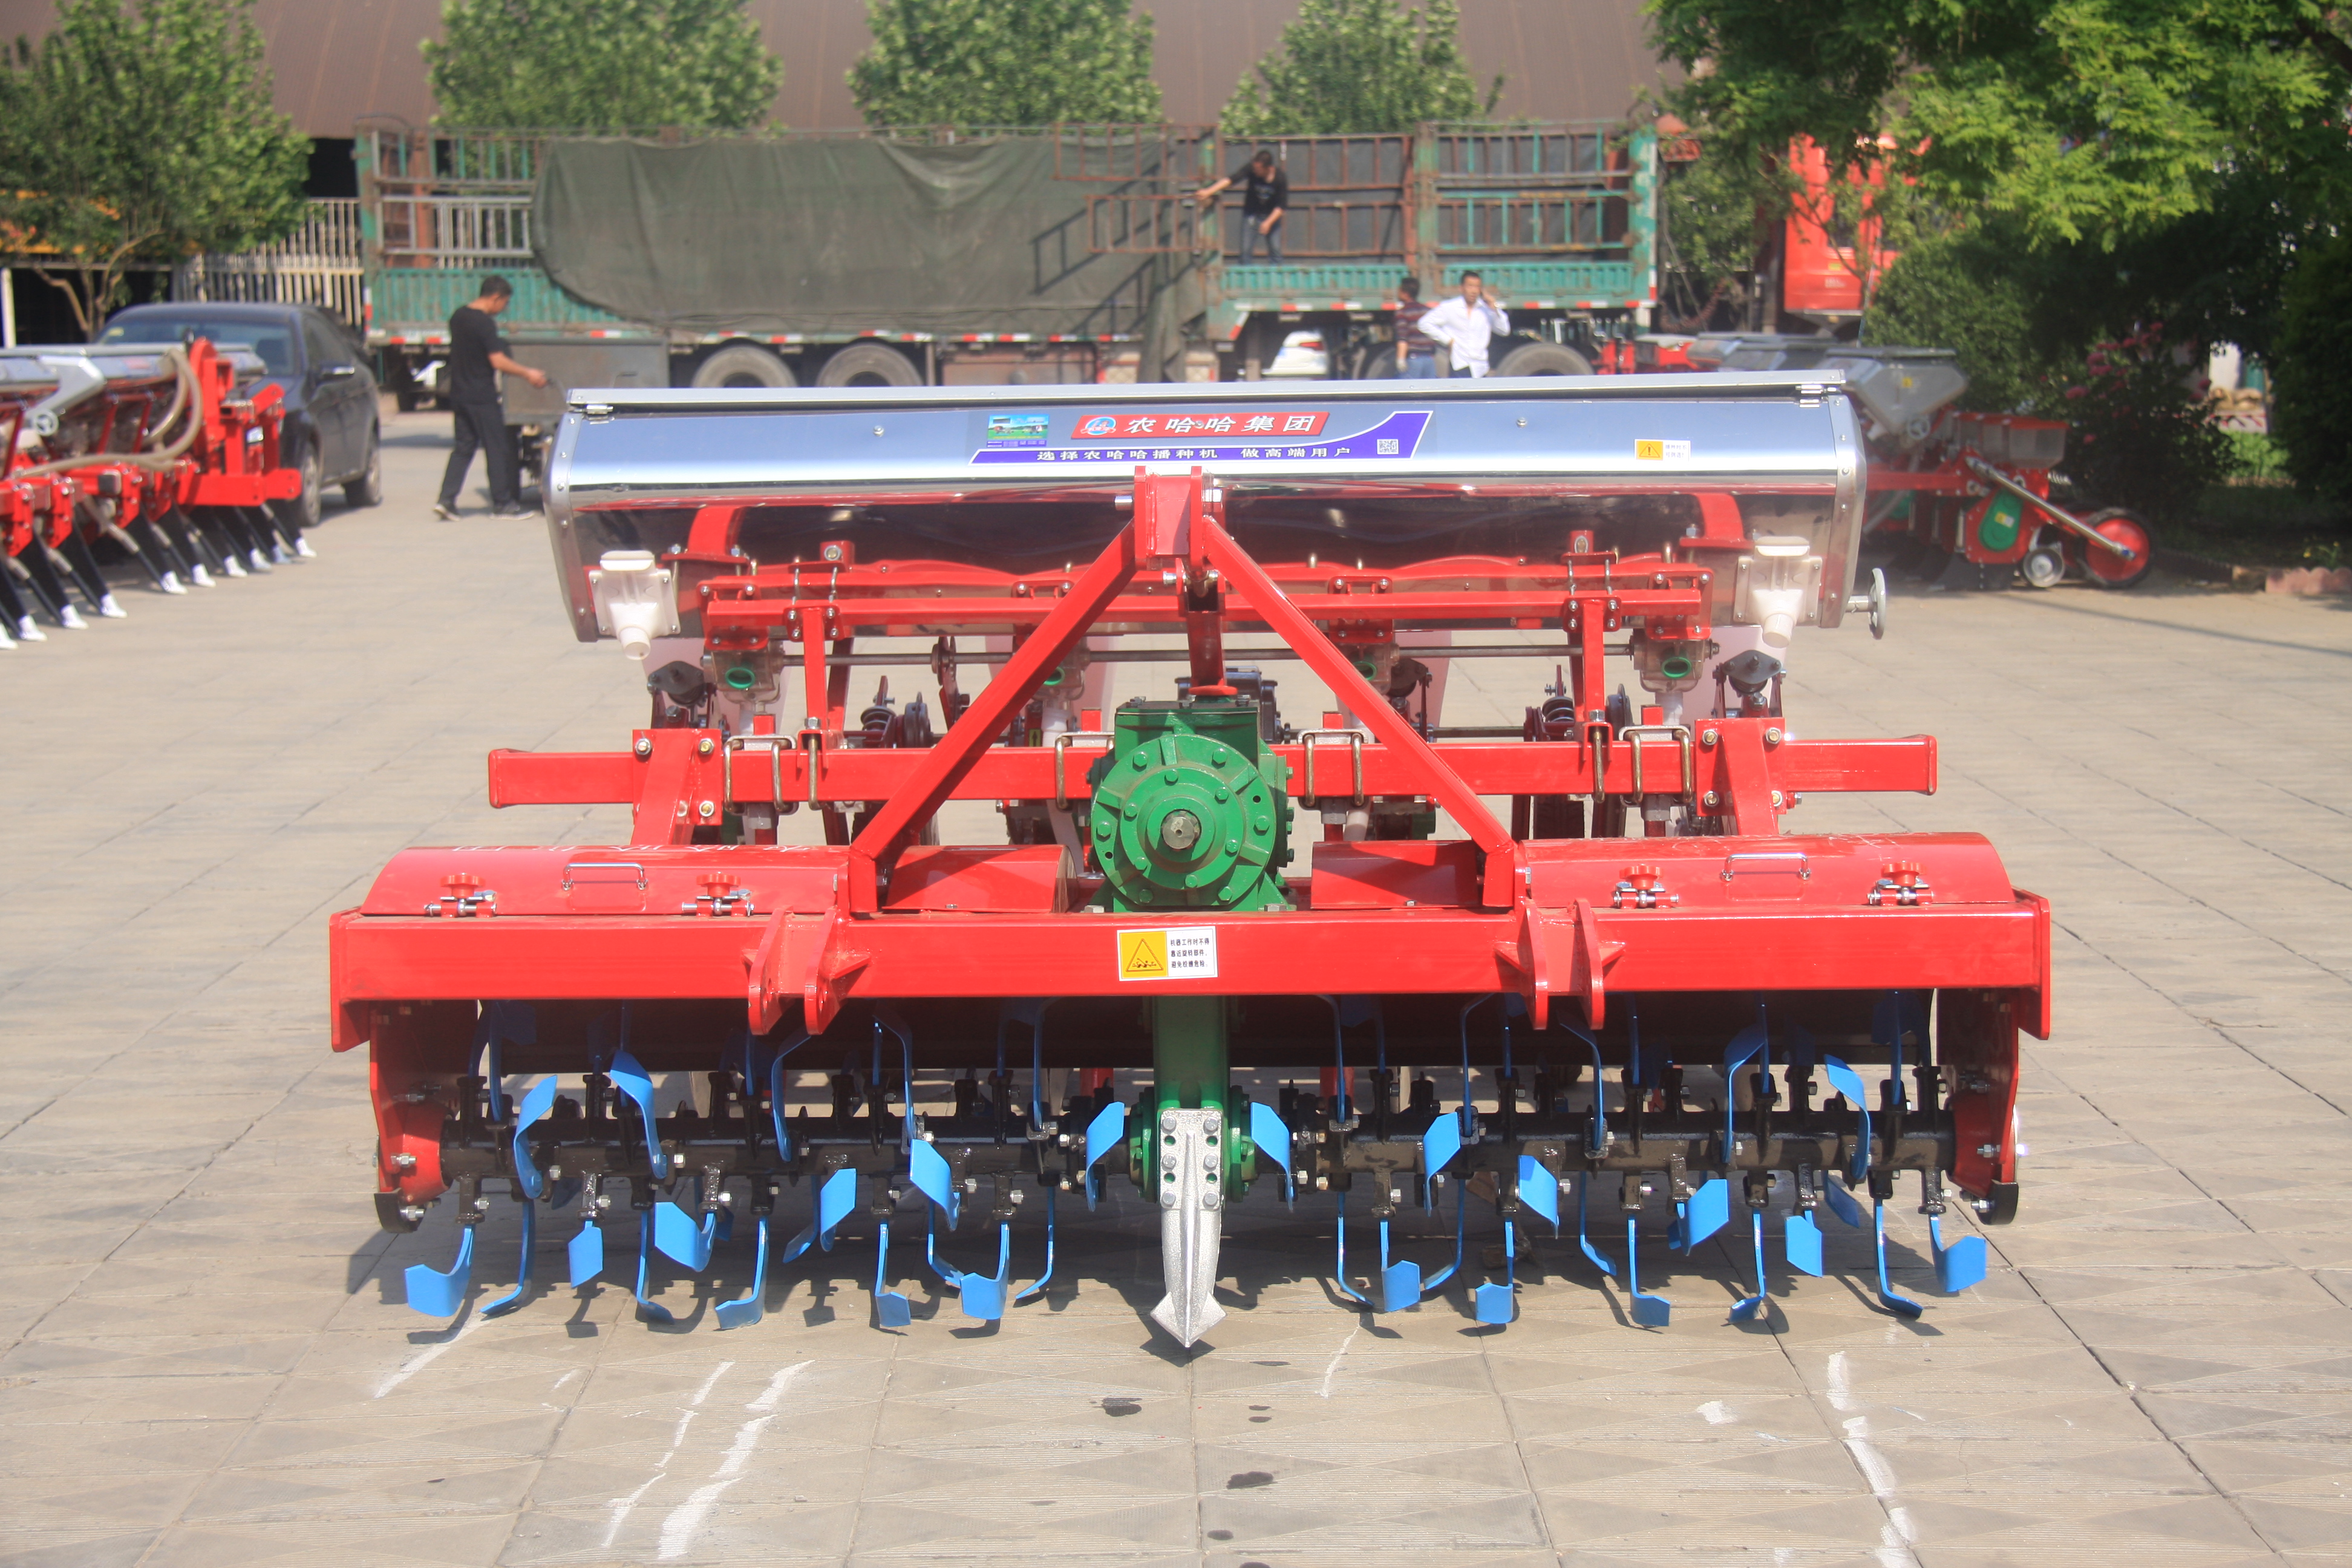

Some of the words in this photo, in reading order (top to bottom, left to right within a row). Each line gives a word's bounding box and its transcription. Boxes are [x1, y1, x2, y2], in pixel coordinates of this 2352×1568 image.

[1123, 416, 1316, 433] 农哈哈集团
[1036, 449, 1218, 461] 选择农哈哈播种机
[1240, 447, 1350, 458] 做高端用户
